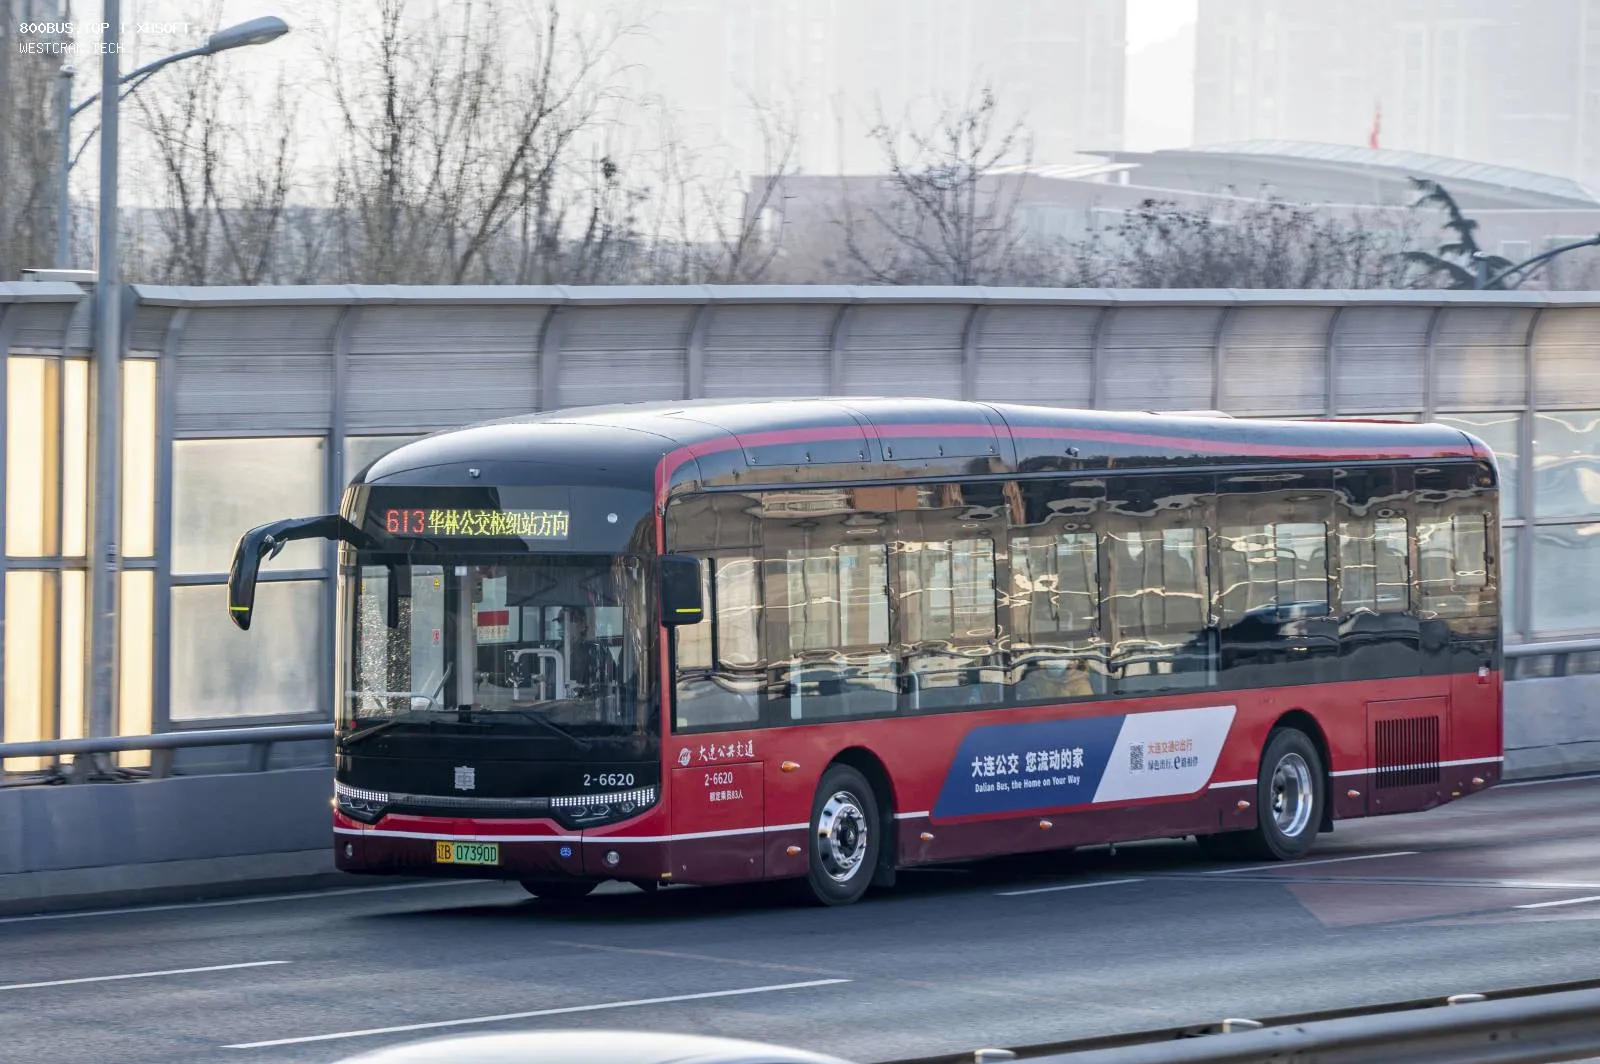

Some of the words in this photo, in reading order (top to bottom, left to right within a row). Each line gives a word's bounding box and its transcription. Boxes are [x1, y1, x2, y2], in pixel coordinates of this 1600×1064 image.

[385, 509, 425, 533] 613
[971, 752, 1020, 778] 大连公交
[1025, 746, 1084, 772] 您流动的家
[583, 773, 635, 787] 2-6620
[705, 771, 733, 787] 2-6620
[975, 783, 995, 793] Dalian
[996, 781, 1010, 792] Bus,
[1011, 779, 1022, 790] the
[1023, 777, 1042, 789] Home
[1043, 778, 1051, 786] on
[1052, 776, 1067, 785] Your
[1067, 774, 1081, 786] Way
